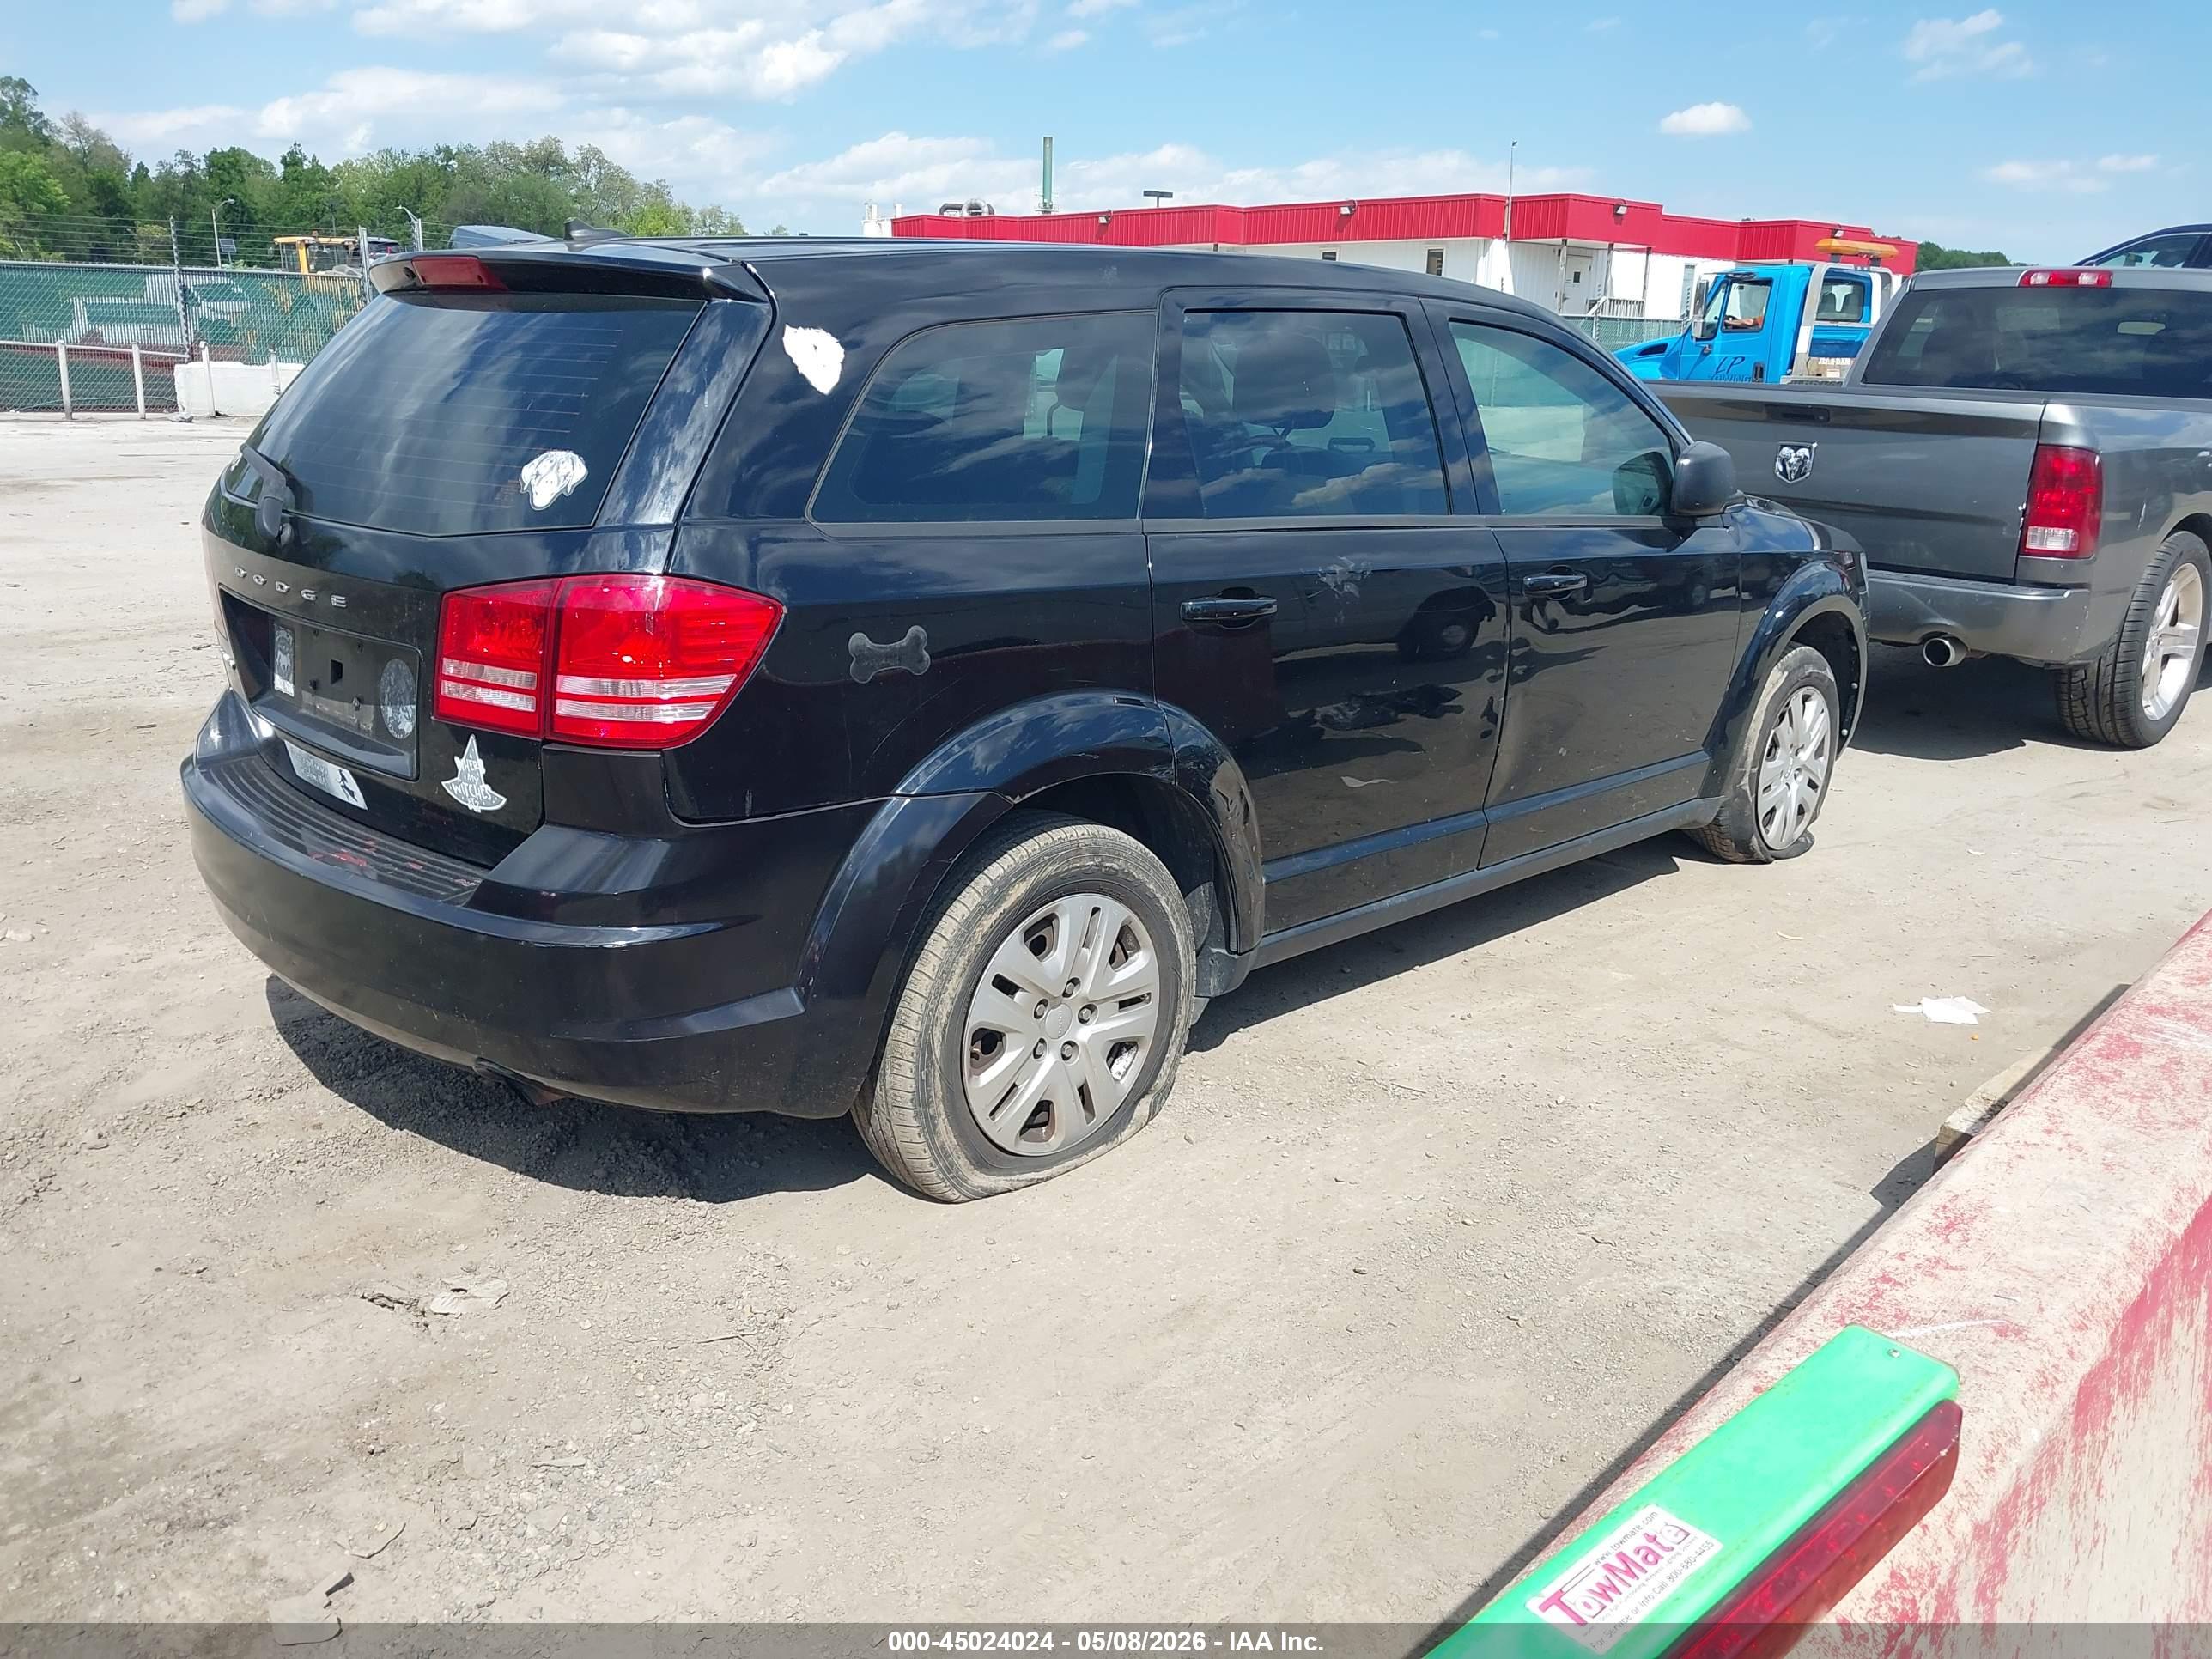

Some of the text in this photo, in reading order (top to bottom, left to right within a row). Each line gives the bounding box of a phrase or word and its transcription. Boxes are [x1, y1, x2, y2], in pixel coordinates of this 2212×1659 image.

[1713, 356, 1746, 376] LP
[234, 566, 347, 608] DODGE
[451, 782, 492, 800] WITCHES
[1538, 1522, 1691, 1627] TowMate
[1652, 1580, 1669, 1595] Call
